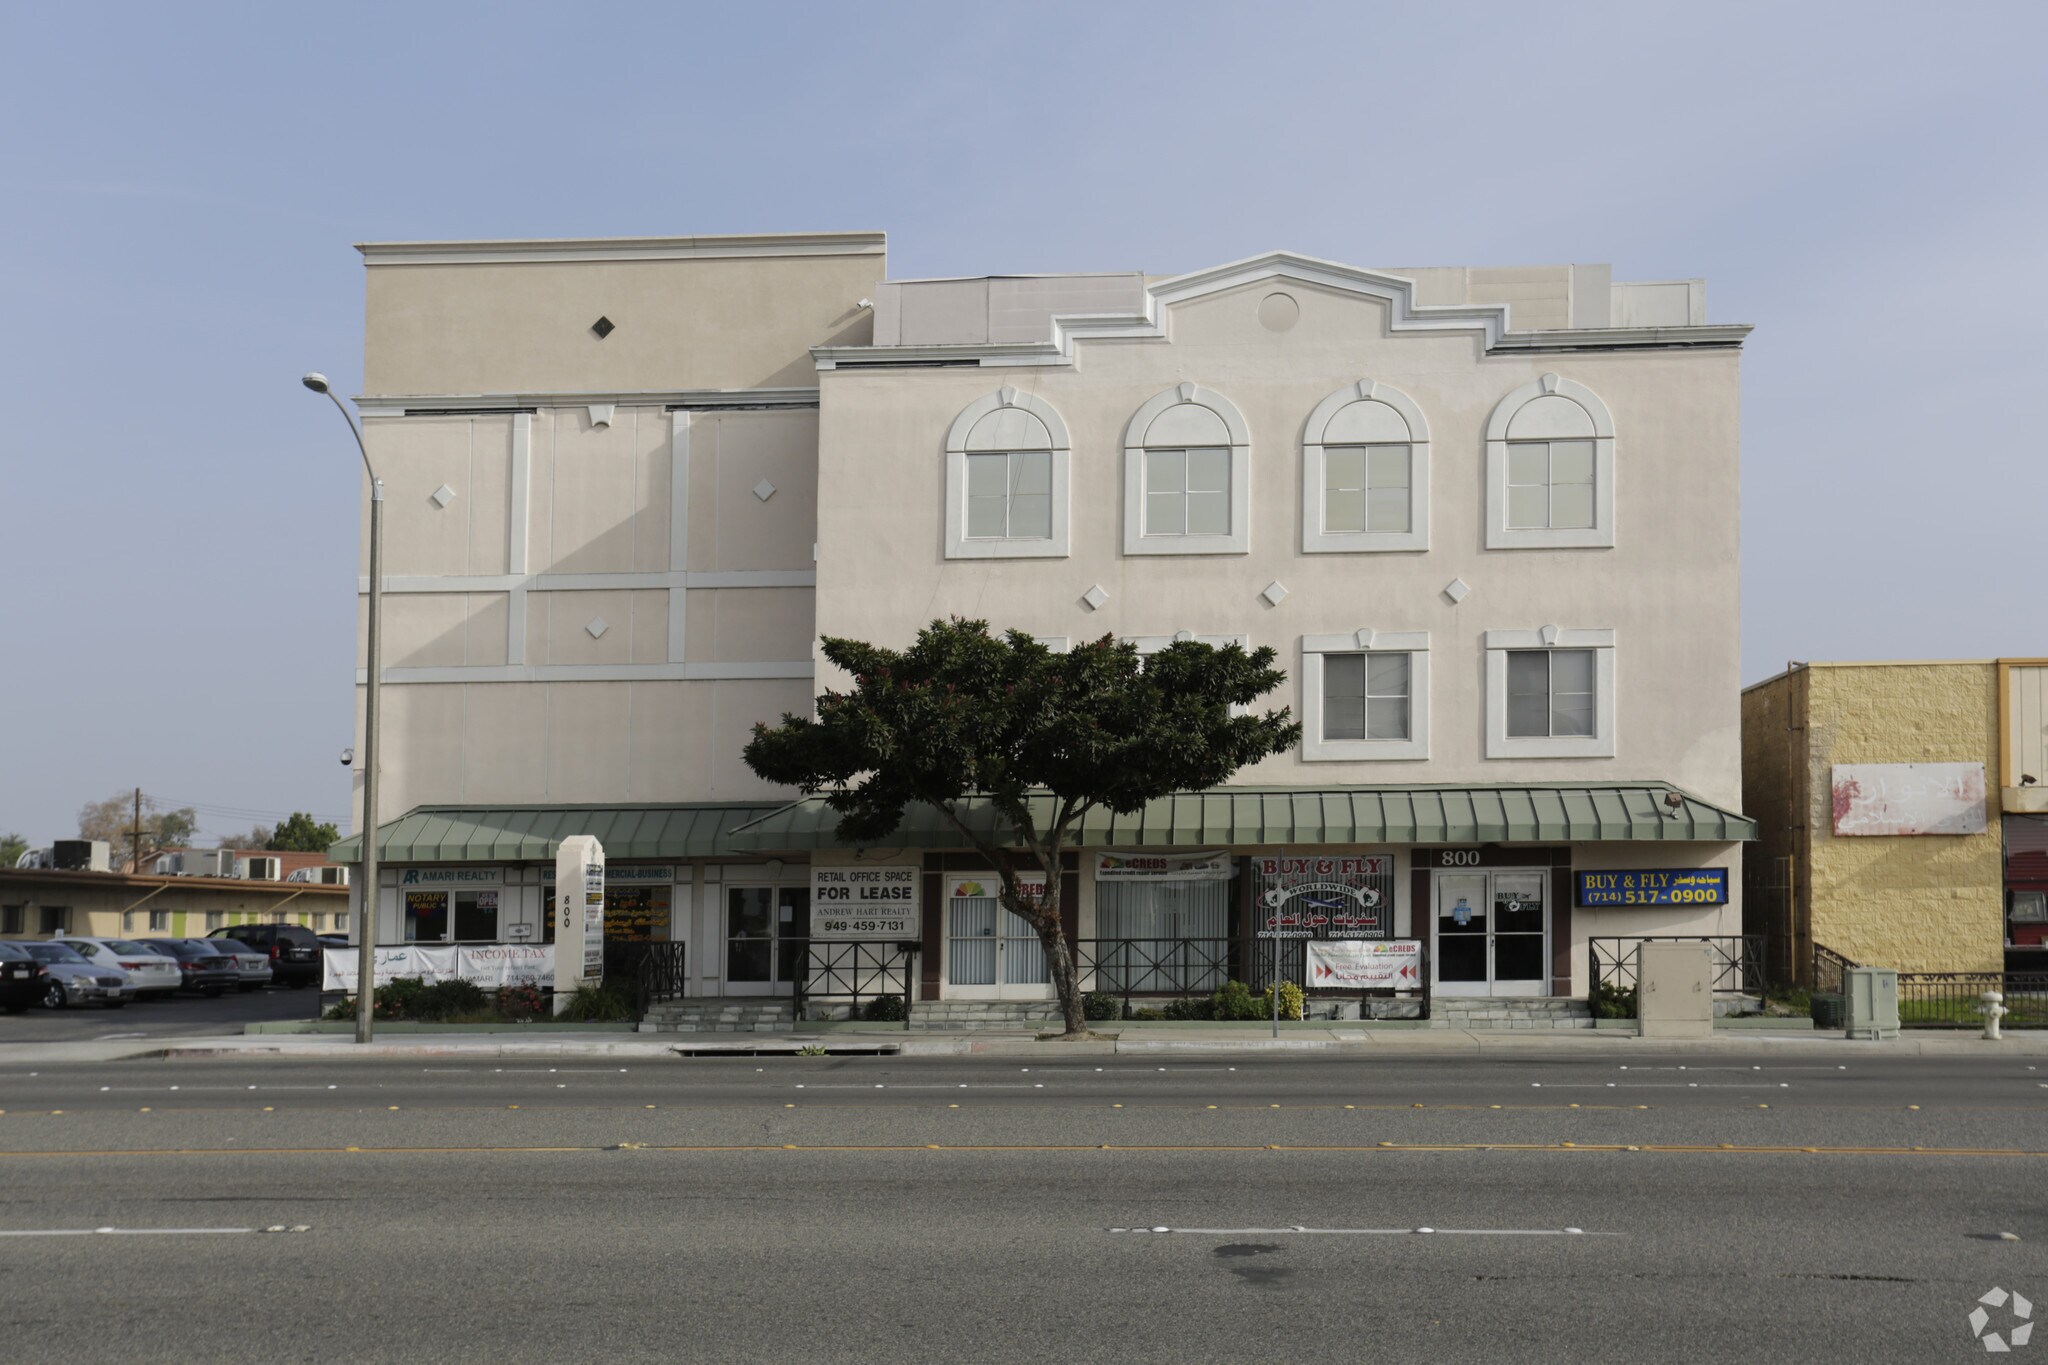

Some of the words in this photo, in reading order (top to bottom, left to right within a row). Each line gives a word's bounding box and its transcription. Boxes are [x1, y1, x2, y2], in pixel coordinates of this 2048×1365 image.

[1125, 858, 1167, 869] eCREDS
[1441, 850, 1480, 866] 800
[1262, 859, 1310, 875] BUY
[1315, 859, 1334, 875] &
[1340, 858, 1382, 875] FLY
[421, 871, 455, 881] AMARI
[457, 871, 497, 881] REALTY
[817, 872, 846, 882] RETAIL
[849, 872, 880, 882] OFFICE
[884, 871, 912, 881] SPACE
[1585, 874, 1618, 889] BUY
[1623, 874, 1635, 888] &
[1640, 873, 1669, 888] FLY
[817, 887, 850, 900] FOR
[860, 886, 912, 900] LEASE
[1289, 883, 1357, 897] WORLDWIDE
[407, 894, 447, 902] NOTARY
[479, 897, 498, 905] OPEN
[1588, 892, 1622, 903] (714)
[1625, 889, 1717, 903] 517-0900
[817, 908, 852, 916] ANDREW
[471, 949, 520, 960] INCOME
[522, 948, 546, 959] TAX
[1389, 944, 1416, 953] eCREDS
[1355, 962, 1394, 970] Evaluation
